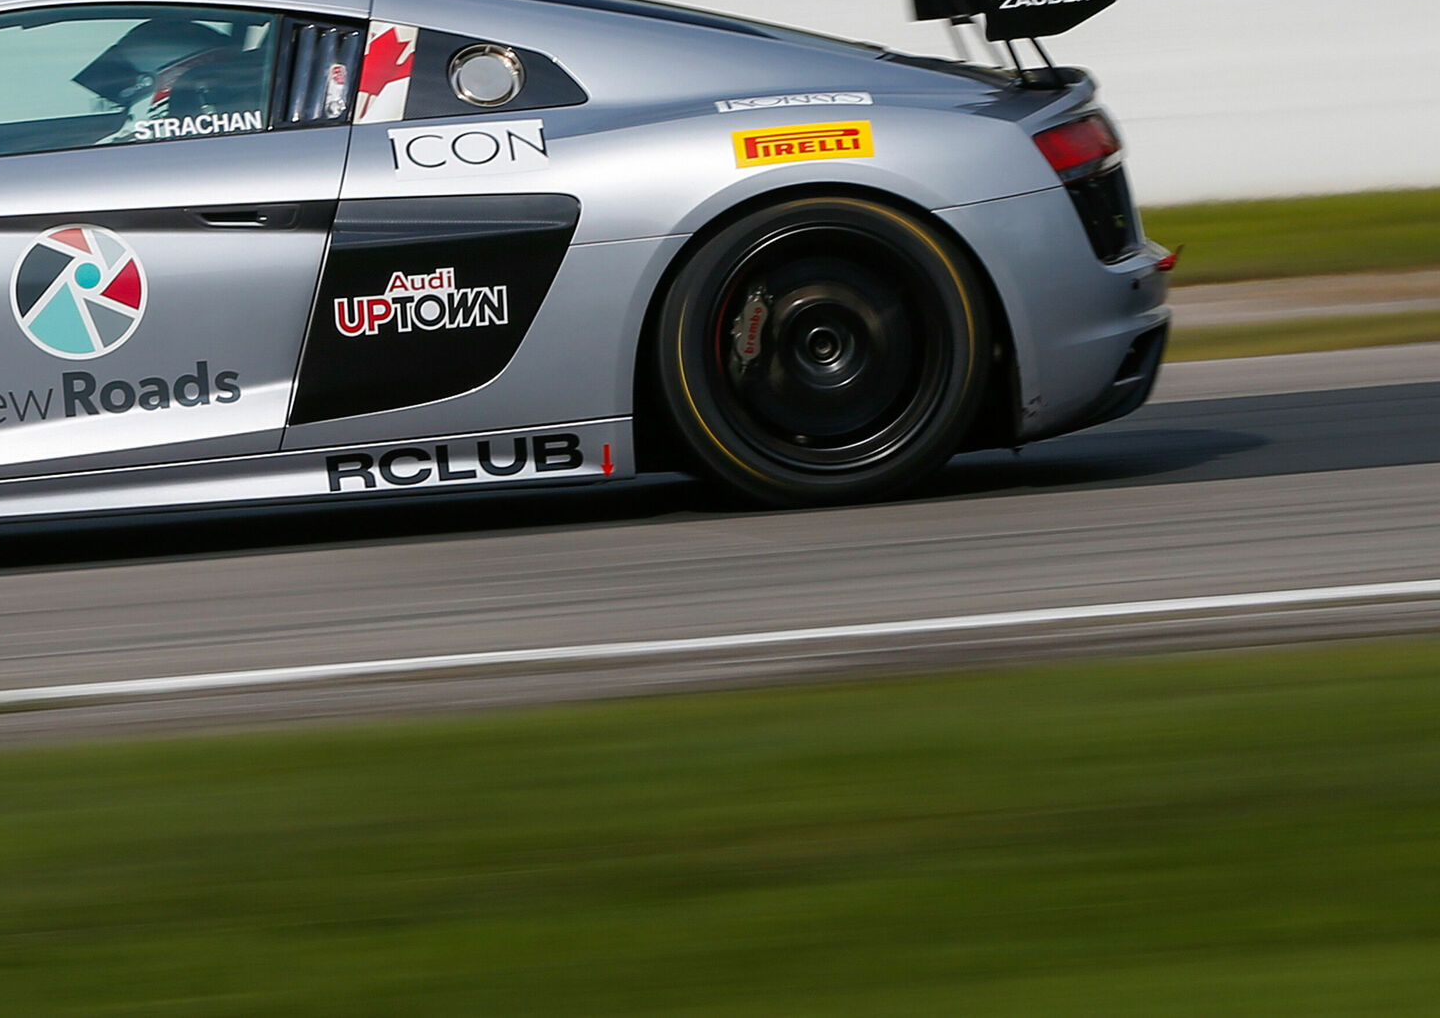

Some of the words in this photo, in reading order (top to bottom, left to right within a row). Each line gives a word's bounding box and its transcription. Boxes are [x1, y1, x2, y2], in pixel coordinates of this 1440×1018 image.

[134, 111, 262, 140] STRACHAN
[744, 128, 860, 159] PIRELLI
[390, 128, 549, 170] ICON
[389, 270, 453, 292] Audi
[336, 286, 507, 335] UPTOWN
[744, 307, 763, 354] brembo
[325, 432, 584, 492] RCLUB
